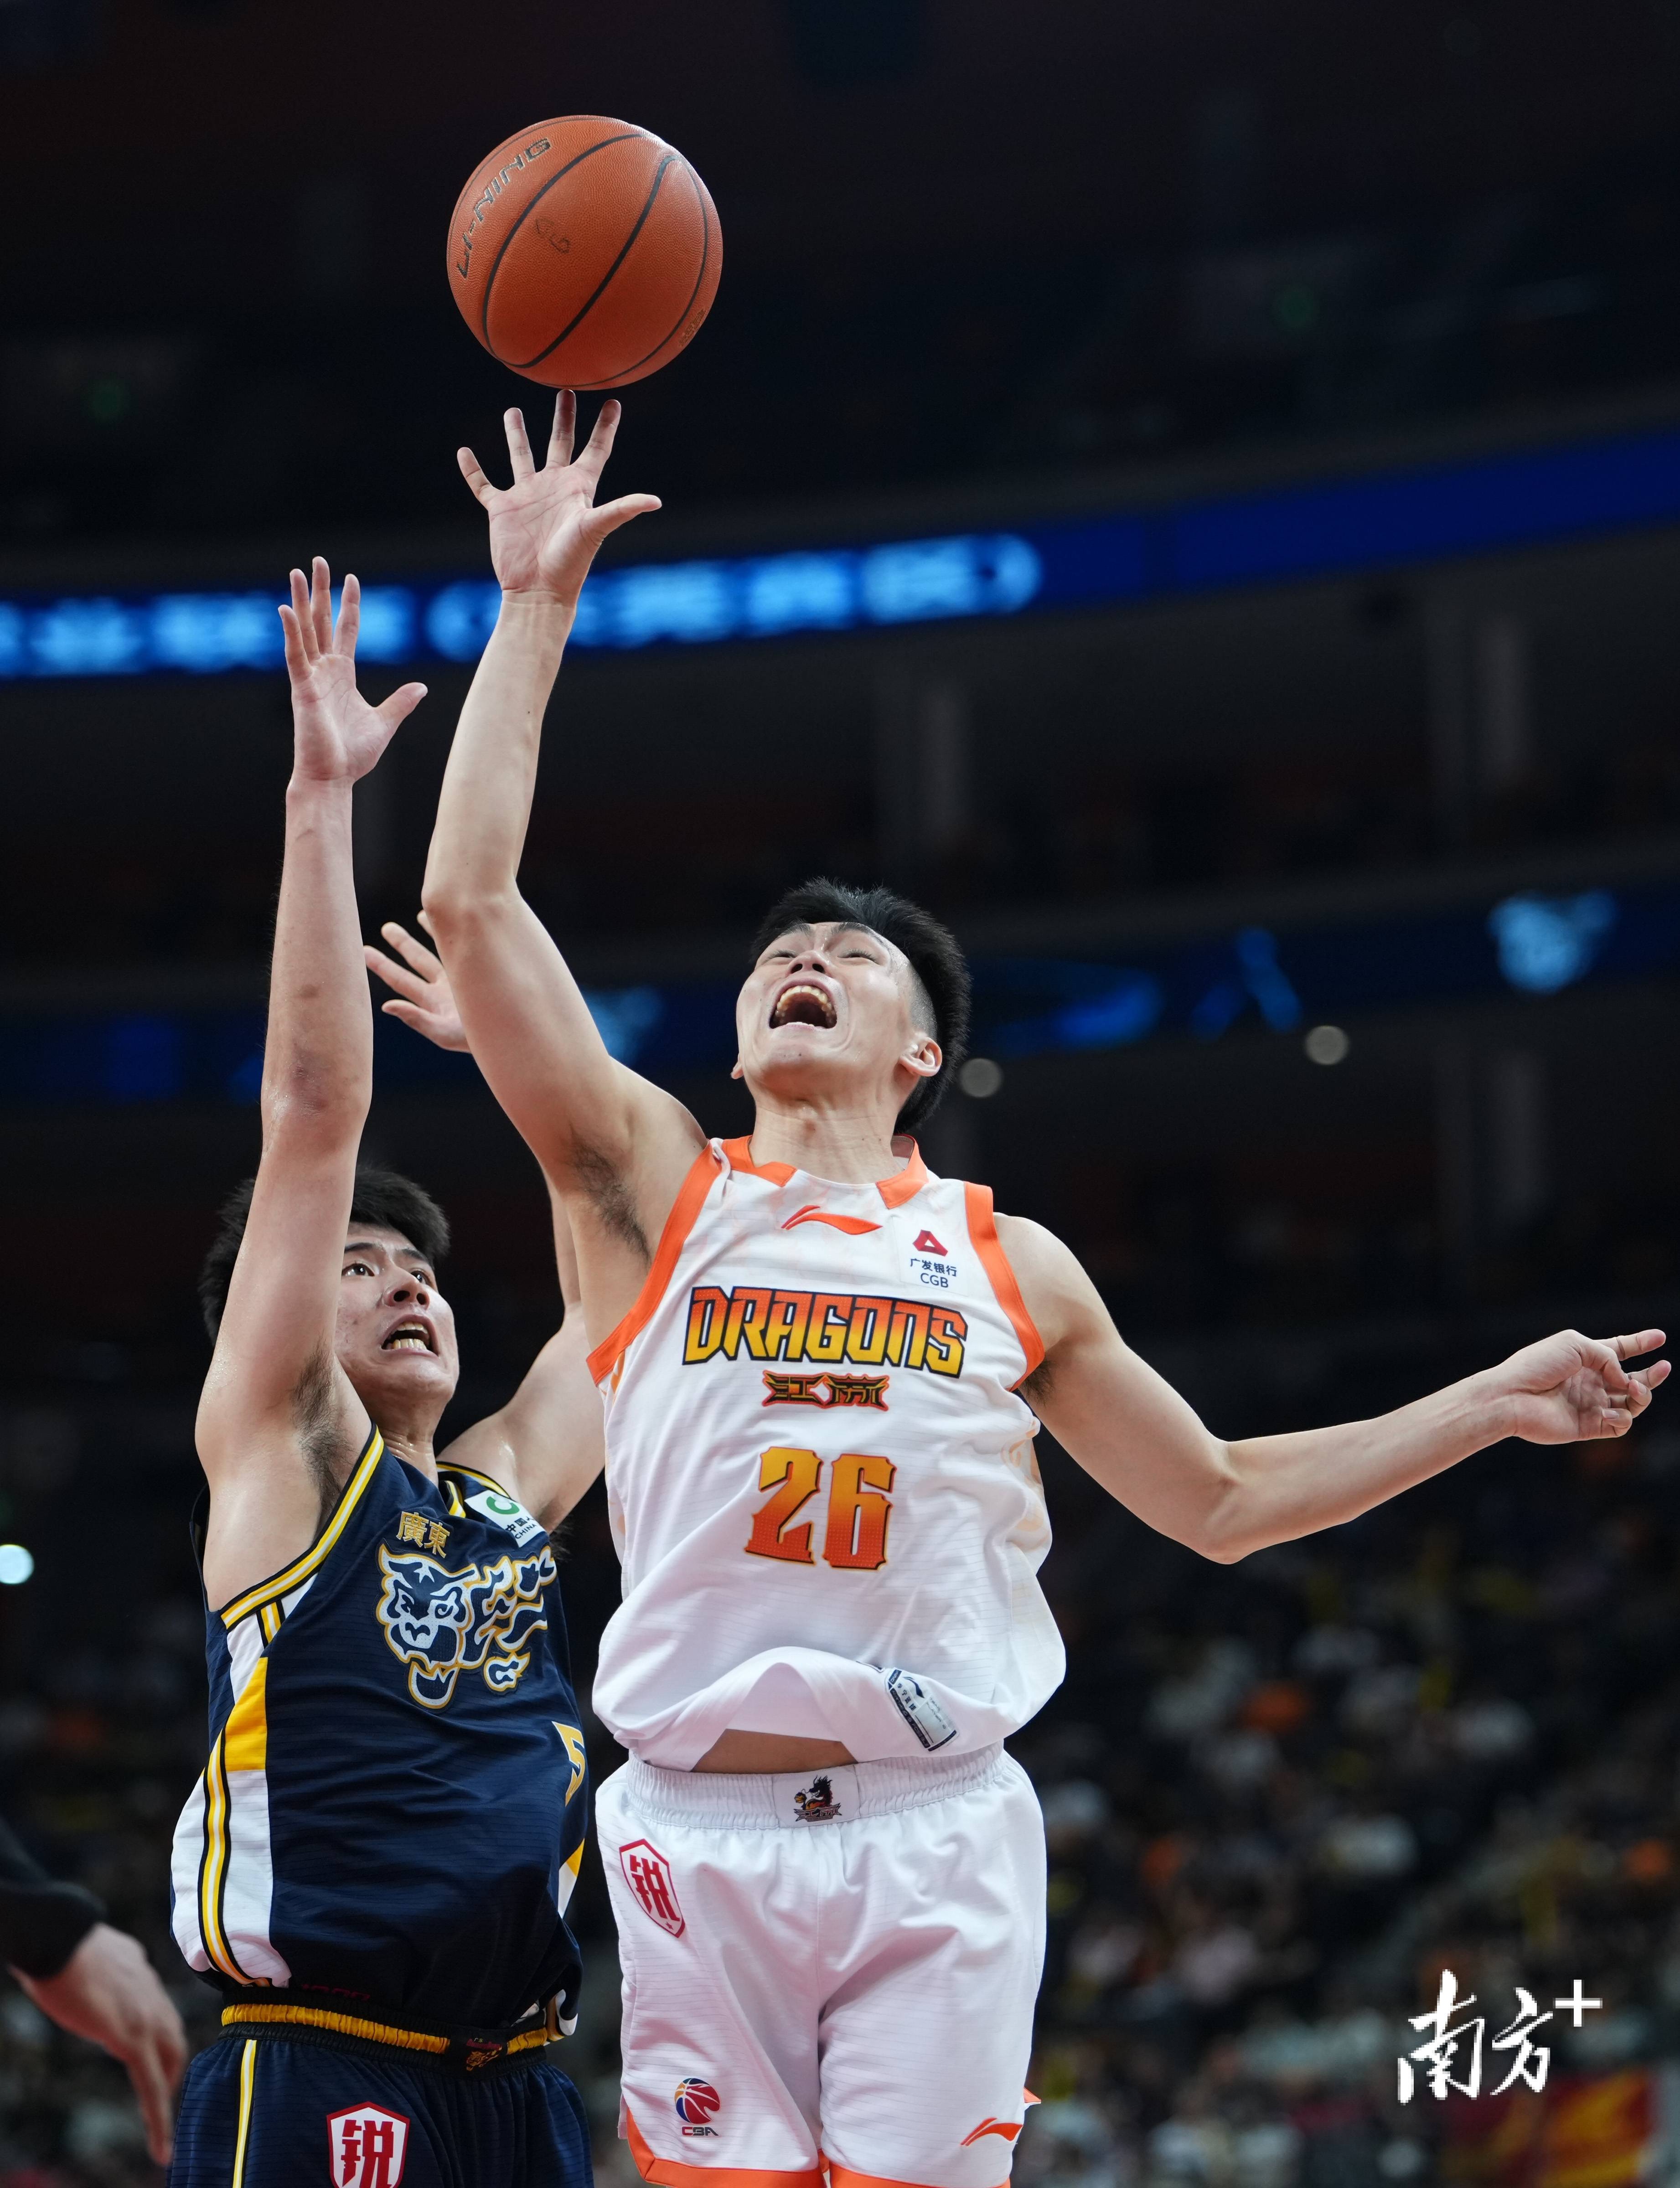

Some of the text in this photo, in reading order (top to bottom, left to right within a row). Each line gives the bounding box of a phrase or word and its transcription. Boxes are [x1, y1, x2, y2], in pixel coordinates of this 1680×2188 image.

[457, 137, 552, 279] LI-NING
[910, 1258, 957, 1277] 广发银行
[920, 1273, 949, 1288] CGB
[682, 1286, 968, 1378] DRAGONS
[744, 1446, 897, 1570] 26
[395, 1511, 450, 1558] 廣東
[515, 1523, 537, 1539] CHINA
[682, 2126, 719, 2136] CBA
